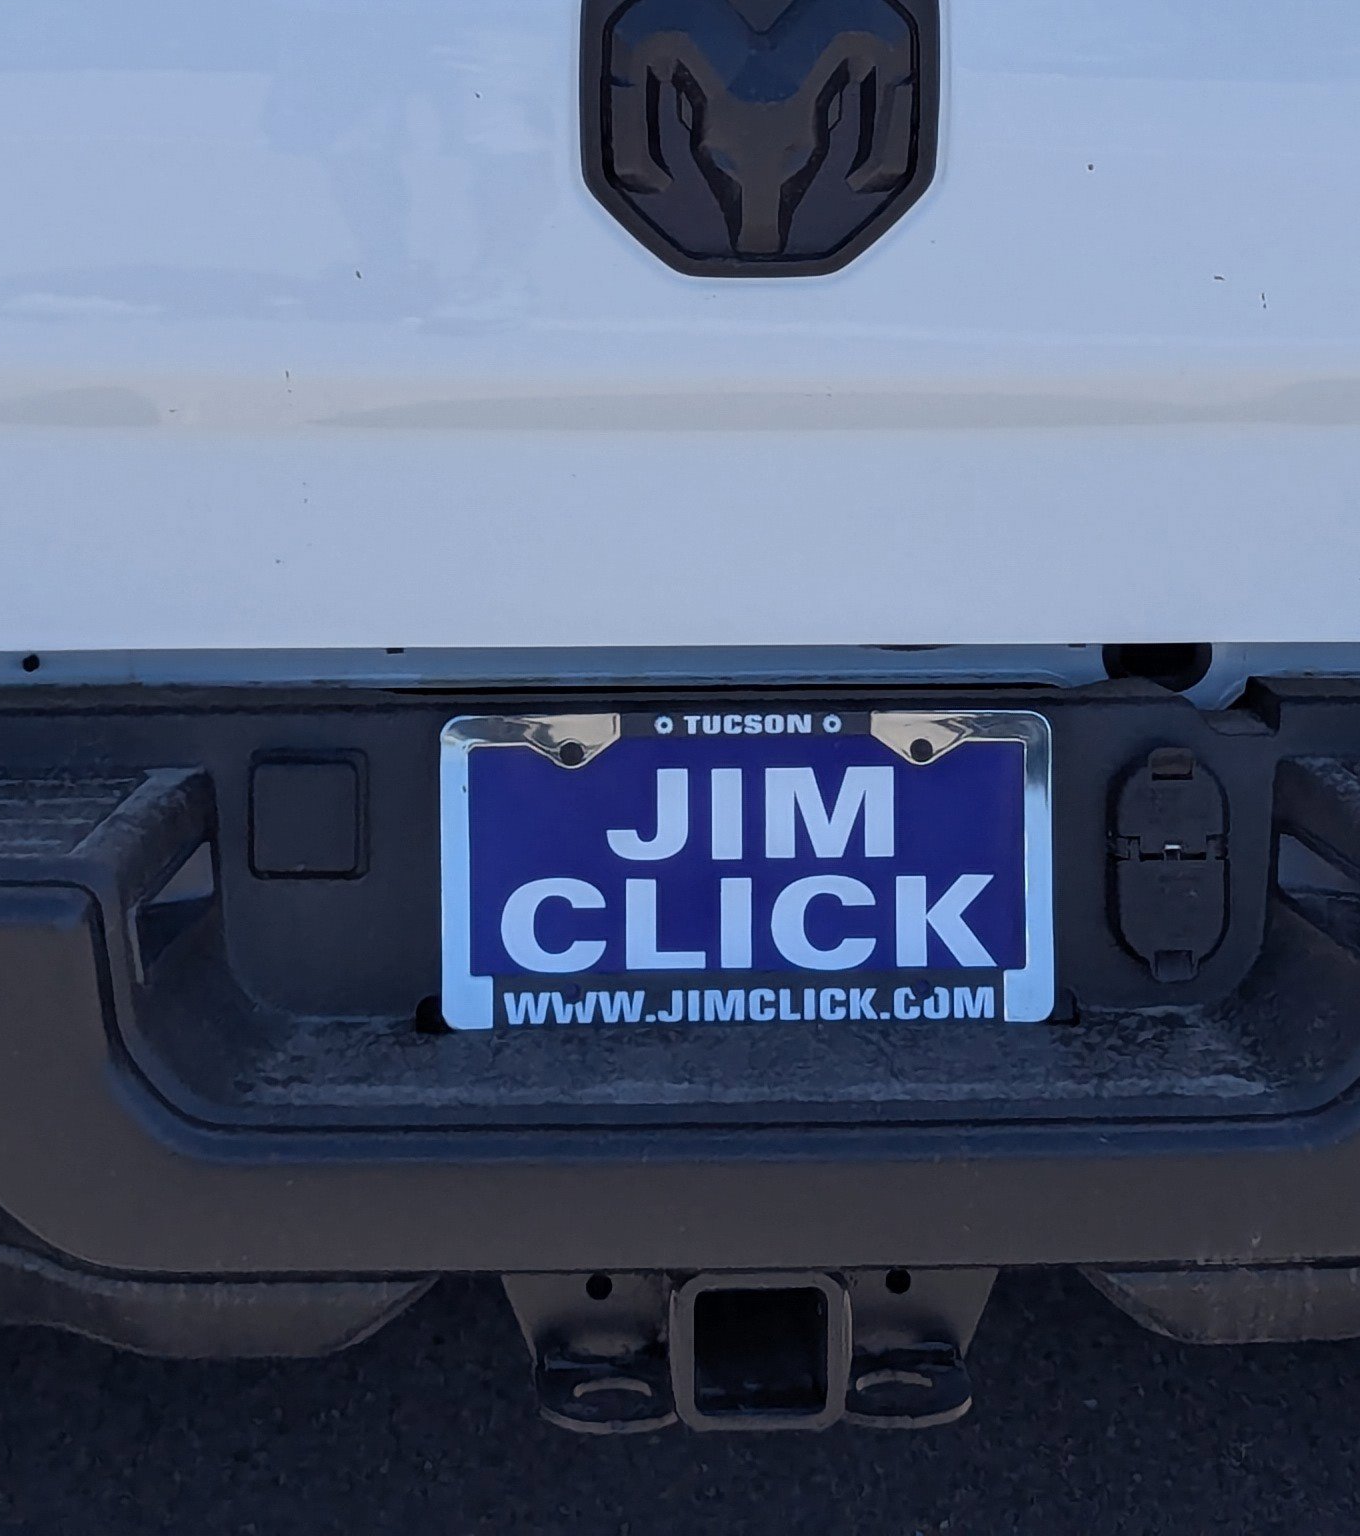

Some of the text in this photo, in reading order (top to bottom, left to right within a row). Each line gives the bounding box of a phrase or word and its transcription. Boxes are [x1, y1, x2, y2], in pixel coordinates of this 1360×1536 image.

[683, 714, 812, 734] TUCSON
[606, 765, 895, 861] JIM
[500, 873, 999, 973] CLICK
[503, 986, 996, 1025] WWW.JIMCLICK.COM
